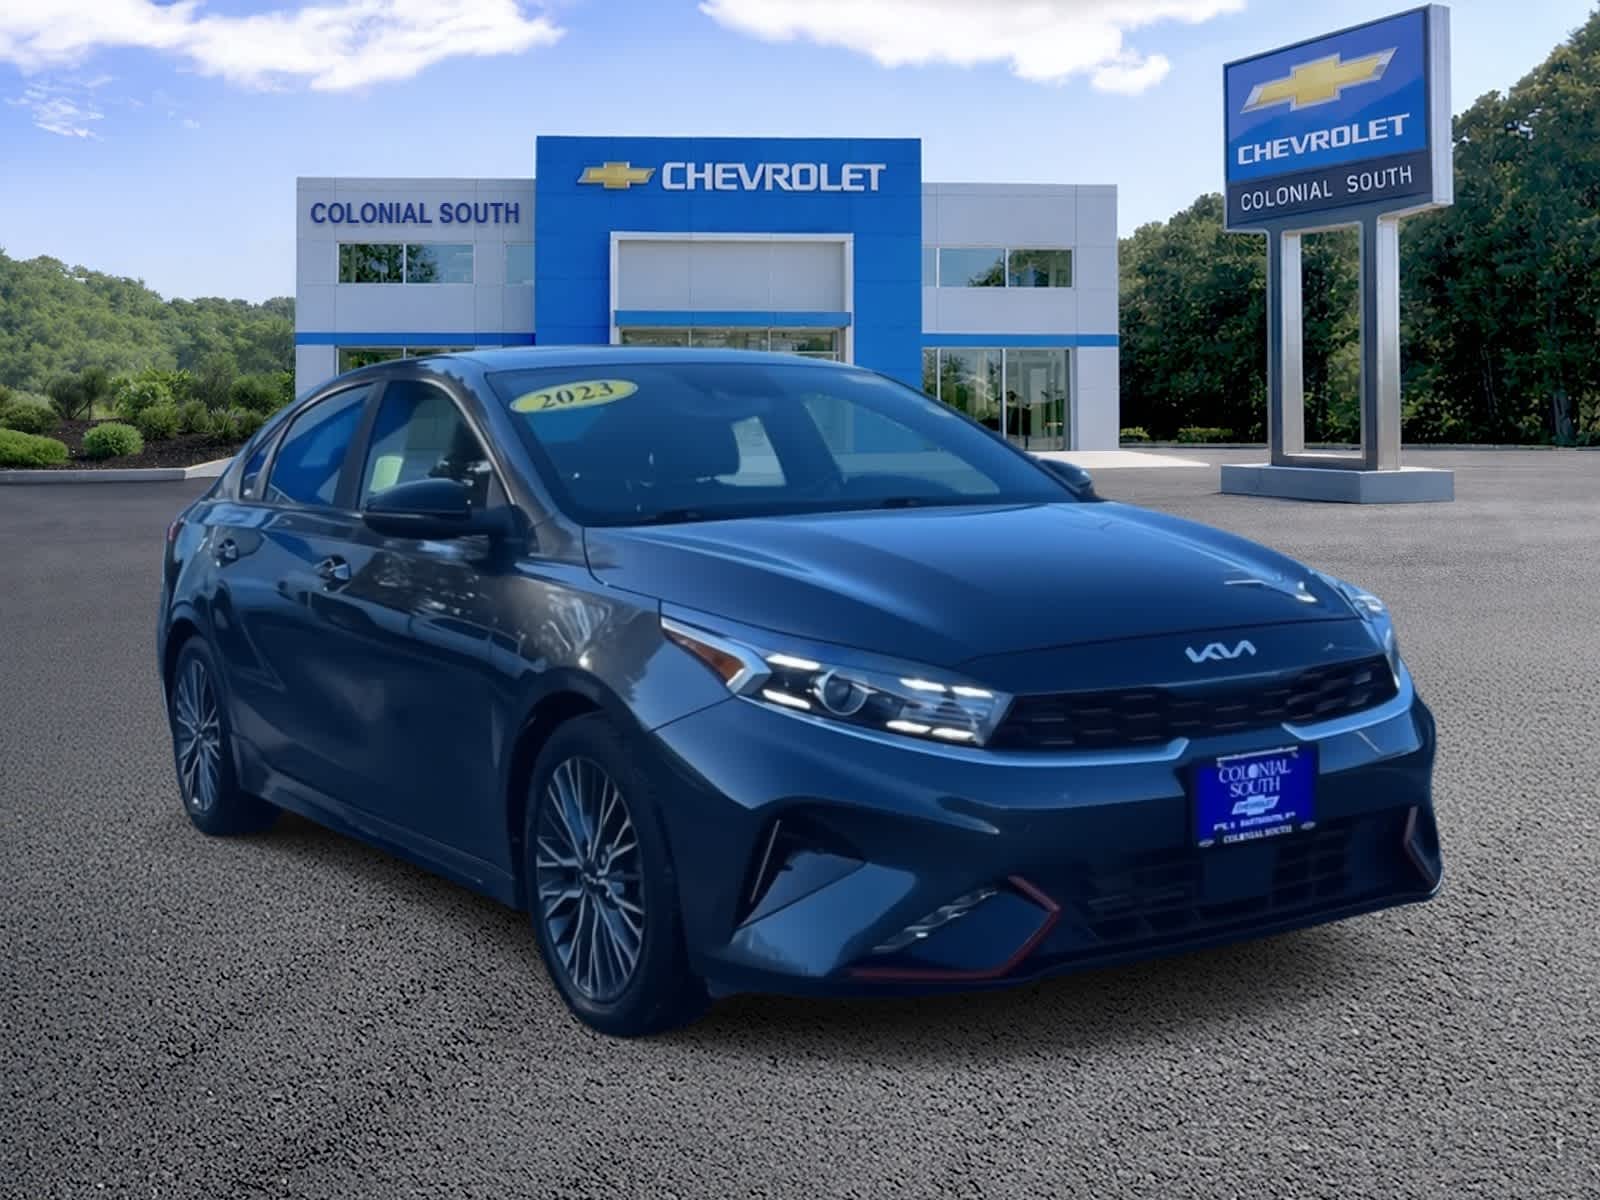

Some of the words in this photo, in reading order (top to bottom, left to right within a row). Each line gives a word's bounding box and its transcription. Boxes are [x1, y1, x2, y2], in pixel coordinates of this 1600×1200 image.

[1237, 113, 1410, 165] CHEVROLET
[661, 161, 887, 192] CHEVROLET
[1240, 180, 1333, 212] COLONIAL
[1346, 165, 1413, 194] SOUTH
[310, 202, 433, 225] COLONIAL
[439, 202, 520, 225] SOUTH
[535, 382, 614, 409] 2023
[1218, 758, 1292, 784] COLONIAL
[1229, 776, 1281, 798] SOUTH
